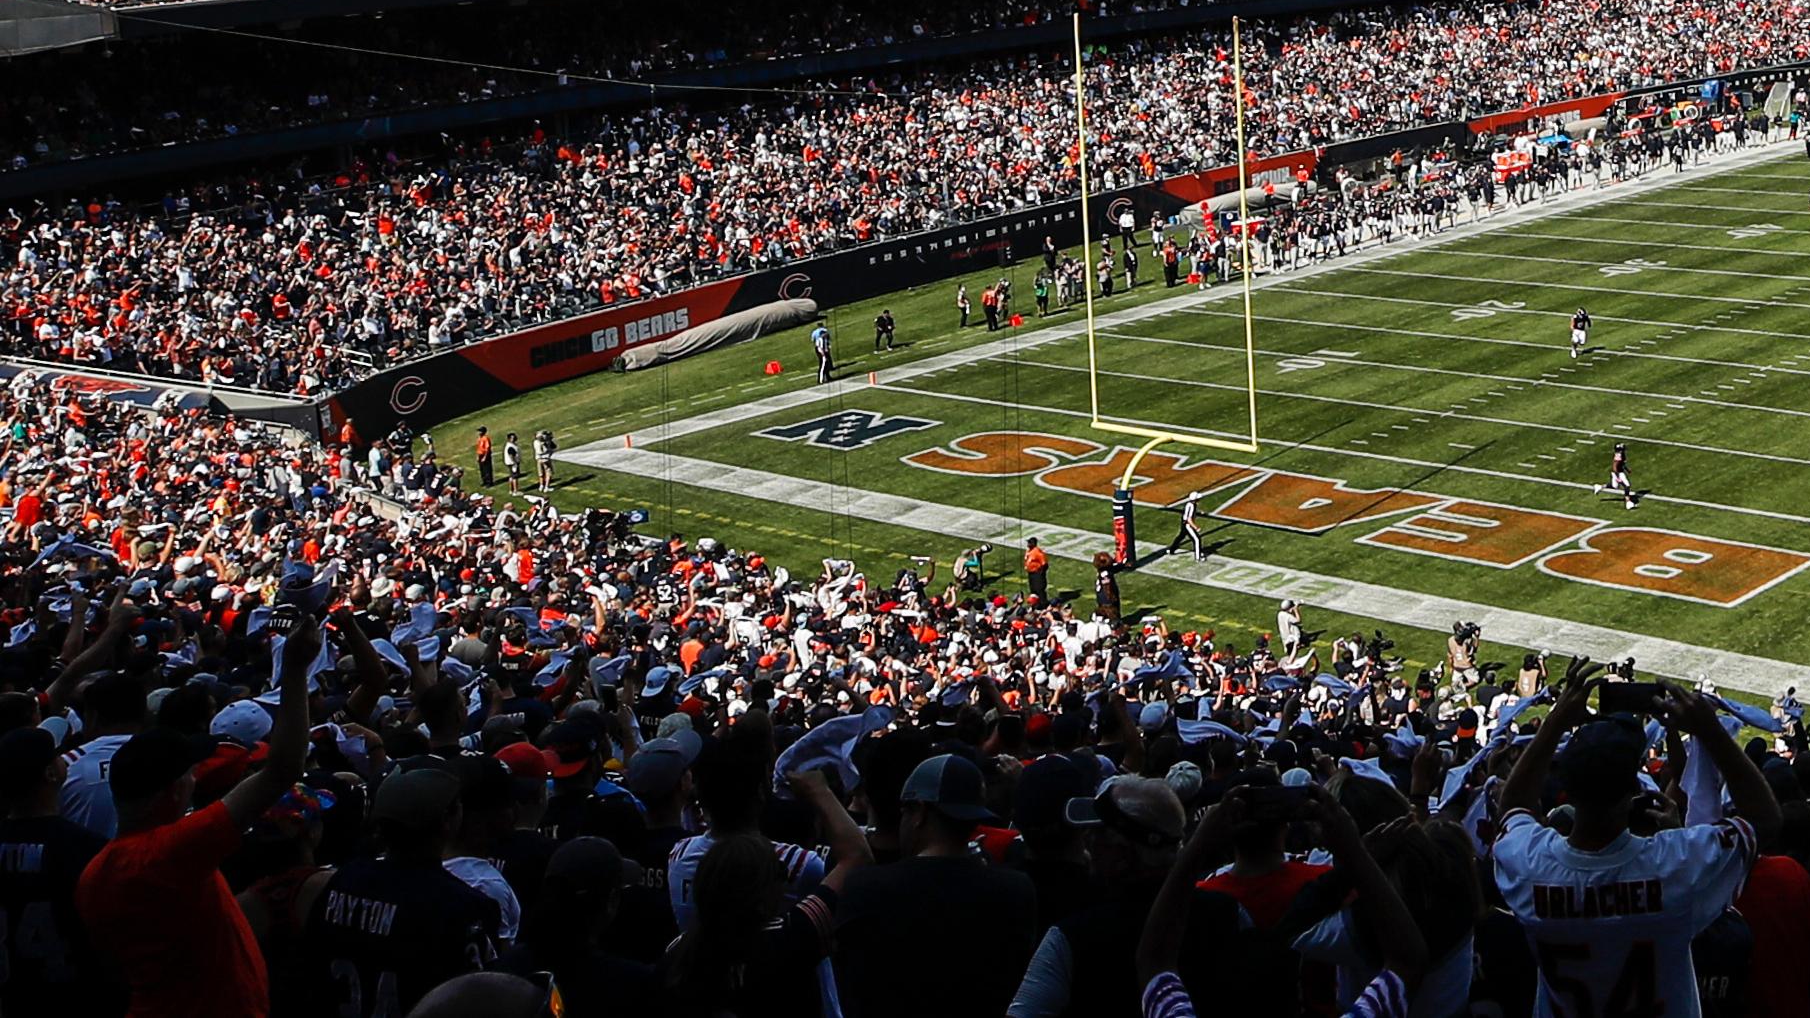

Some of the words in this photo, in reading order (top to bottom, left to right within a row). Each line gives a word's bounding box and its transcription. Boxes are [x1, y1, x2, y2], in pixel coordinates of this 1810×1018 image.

[624, 307, 690, 344] BEARS
[656, 584, 673, 602] 52
[1208, 566, 1337, 598] END
[324, 889, 400, 938] PAYTON
[1533, 880, 1663, 920] URLACHER
